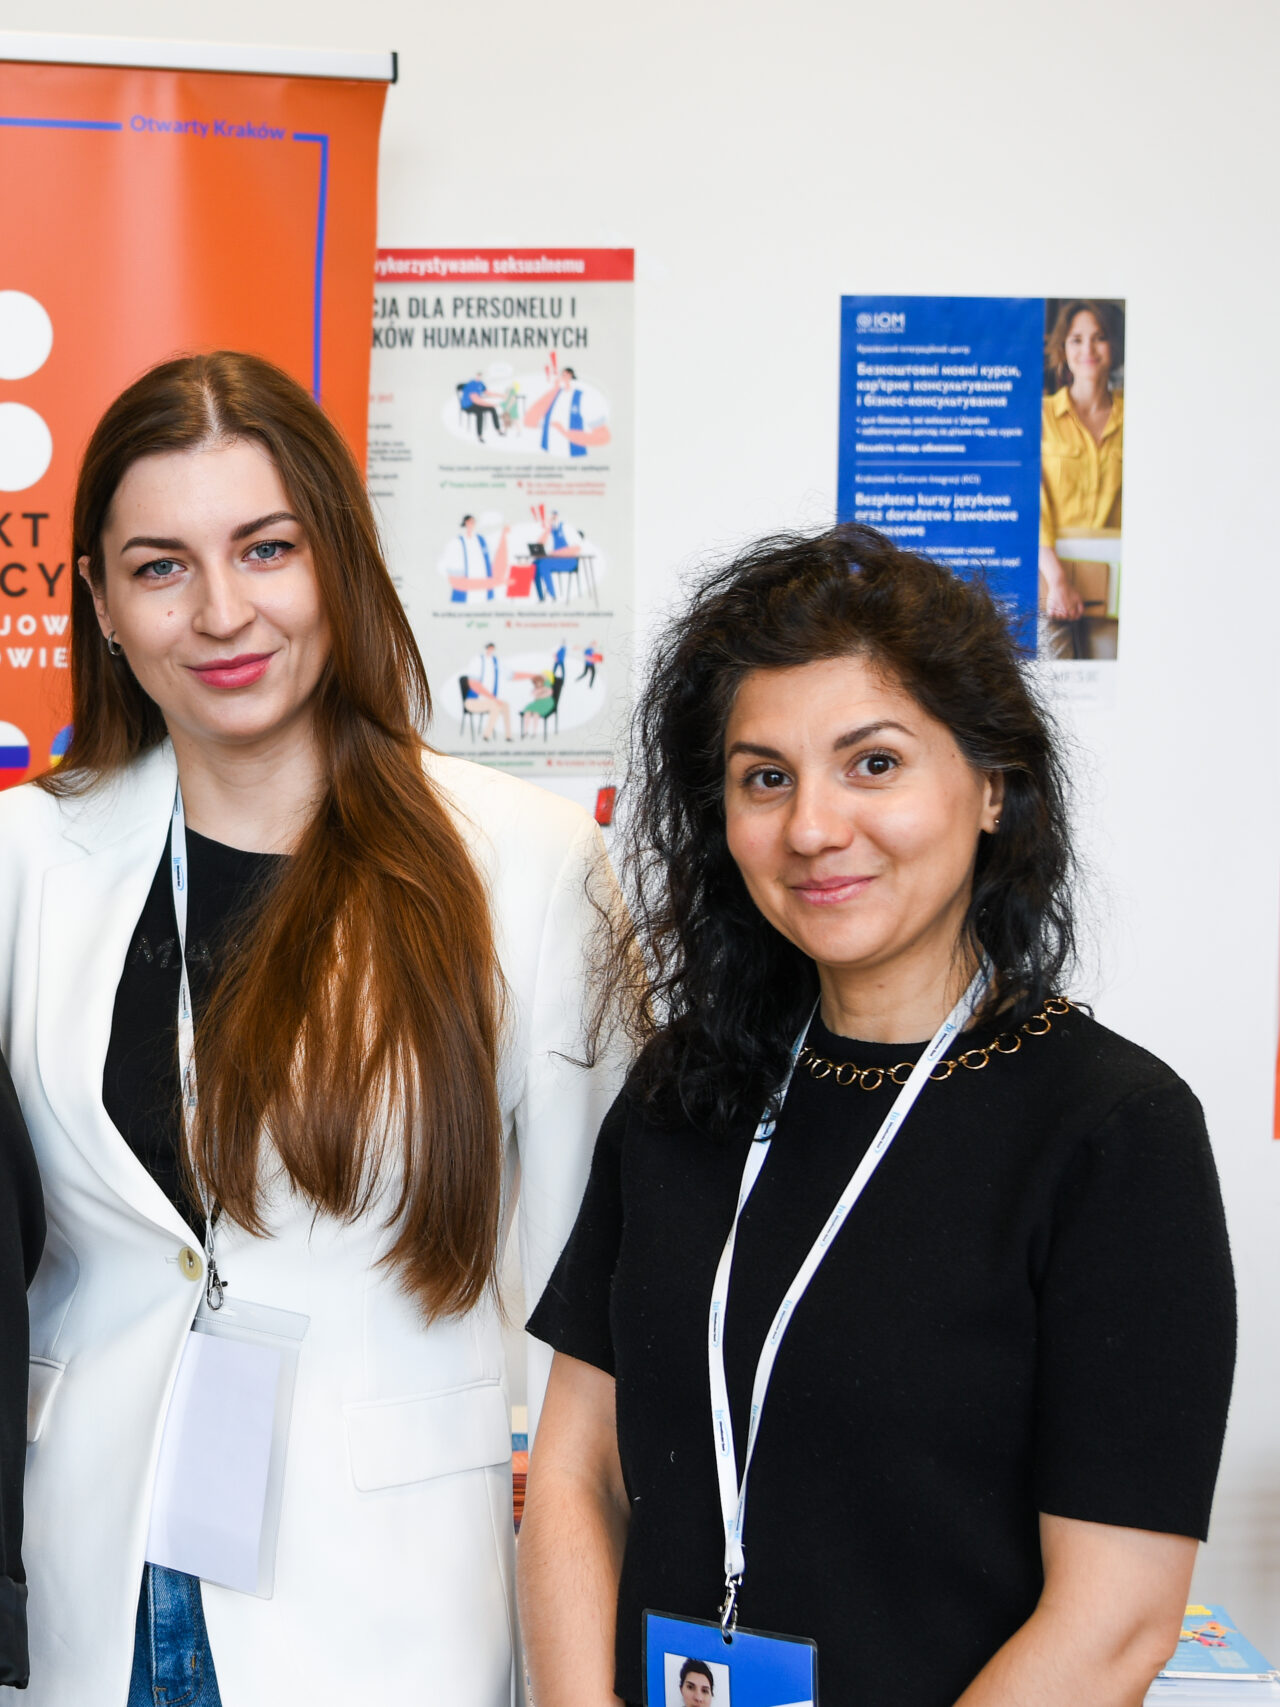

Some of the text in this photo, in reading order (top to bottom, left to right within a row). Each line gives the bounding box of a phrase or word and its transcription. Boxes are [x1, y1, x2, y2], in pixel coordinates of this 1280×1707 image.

[130, 114, 286, 140] Otwarty Kraków
[492, 254, 585, 274] seksualnemu
[408, 297, 444, 319] DLA
[453, 297, 563, 319] PERSONELU
[571, 297, 576, 319] I
[873, 312, 906, 328] IOM
[373, 321, 588, 349] KÓW HUMANITARNYCH
[917, 492, 952, 509] kursy
[885, 508, 952, 522] doradztwo
[954, 508, 1019, 522] zawodowe
